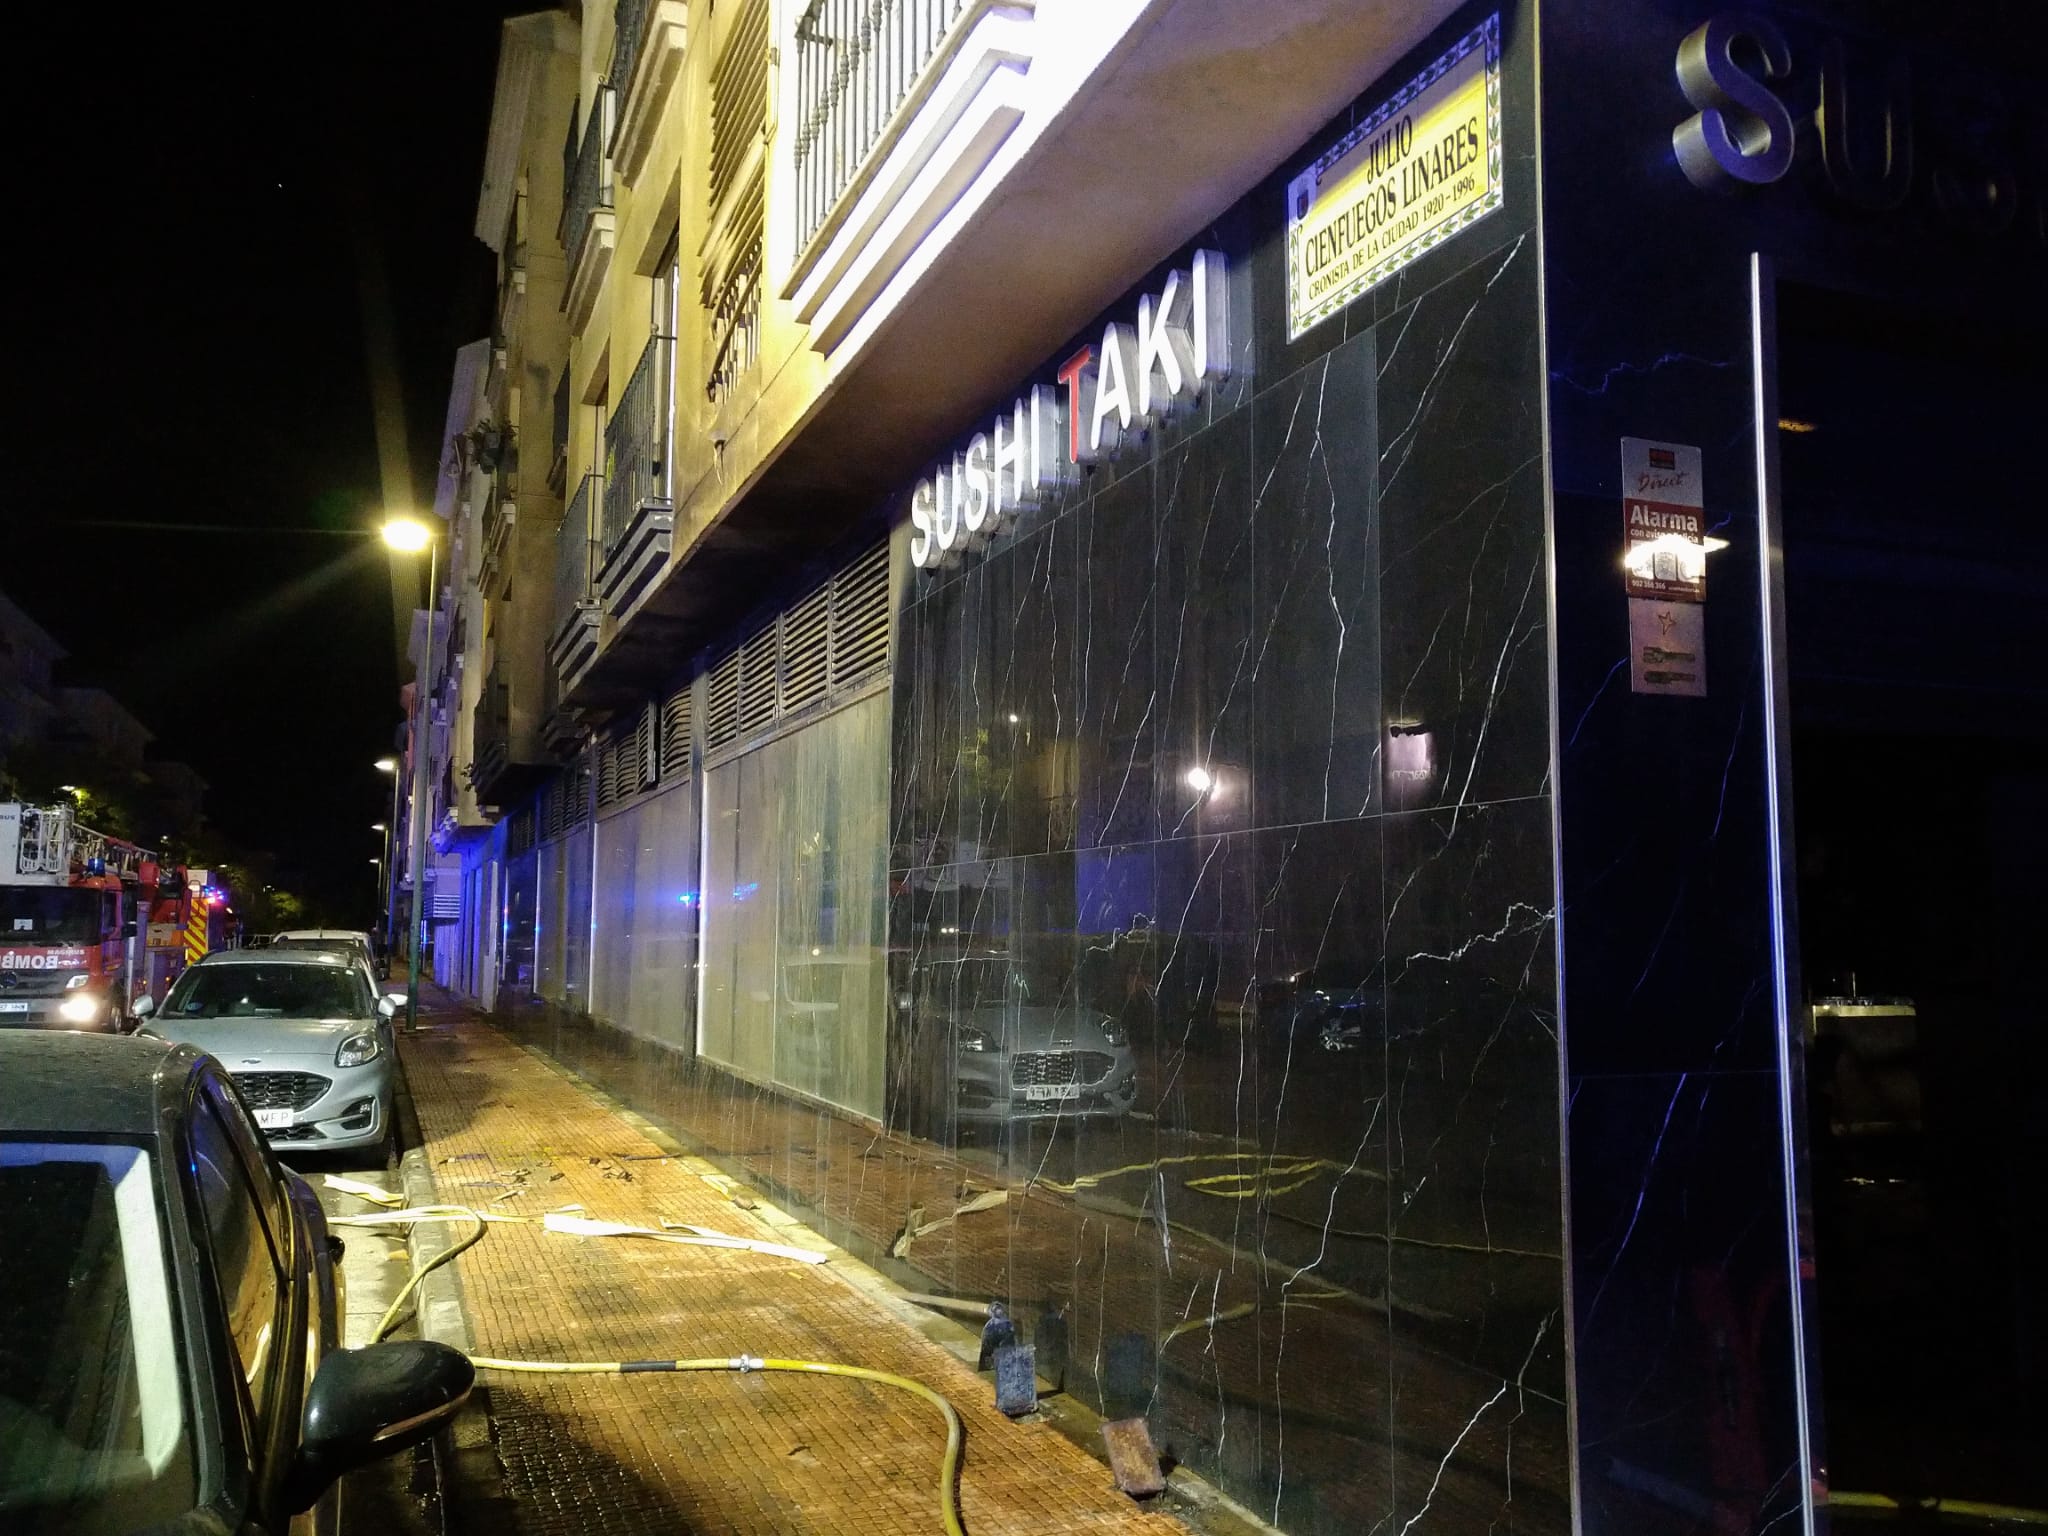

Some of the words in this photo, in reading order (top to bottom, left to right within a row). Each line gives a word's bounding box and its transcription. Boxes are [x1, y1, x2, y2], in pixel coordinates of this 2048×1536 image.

[1366, 114, 1413, 184] JULIO
[1305, 176, 1396, 278] CIENFUEGOS
[1403, 116, 1479, 208] LINARES
[1308, 259, 1350, 301] CRONISTA
[1352, 251, 1365, 271] DE
[1367, 242, 1380, 261] LA
[1382, 211, 1419, 250] CIUDAD
[910, 383, 1042, 568] SUSHI
[1058, 247, 1209, 465] TAKI
[1630, 504, 1699, 533] Alarma
[1630, 528, 1645, 537] con
